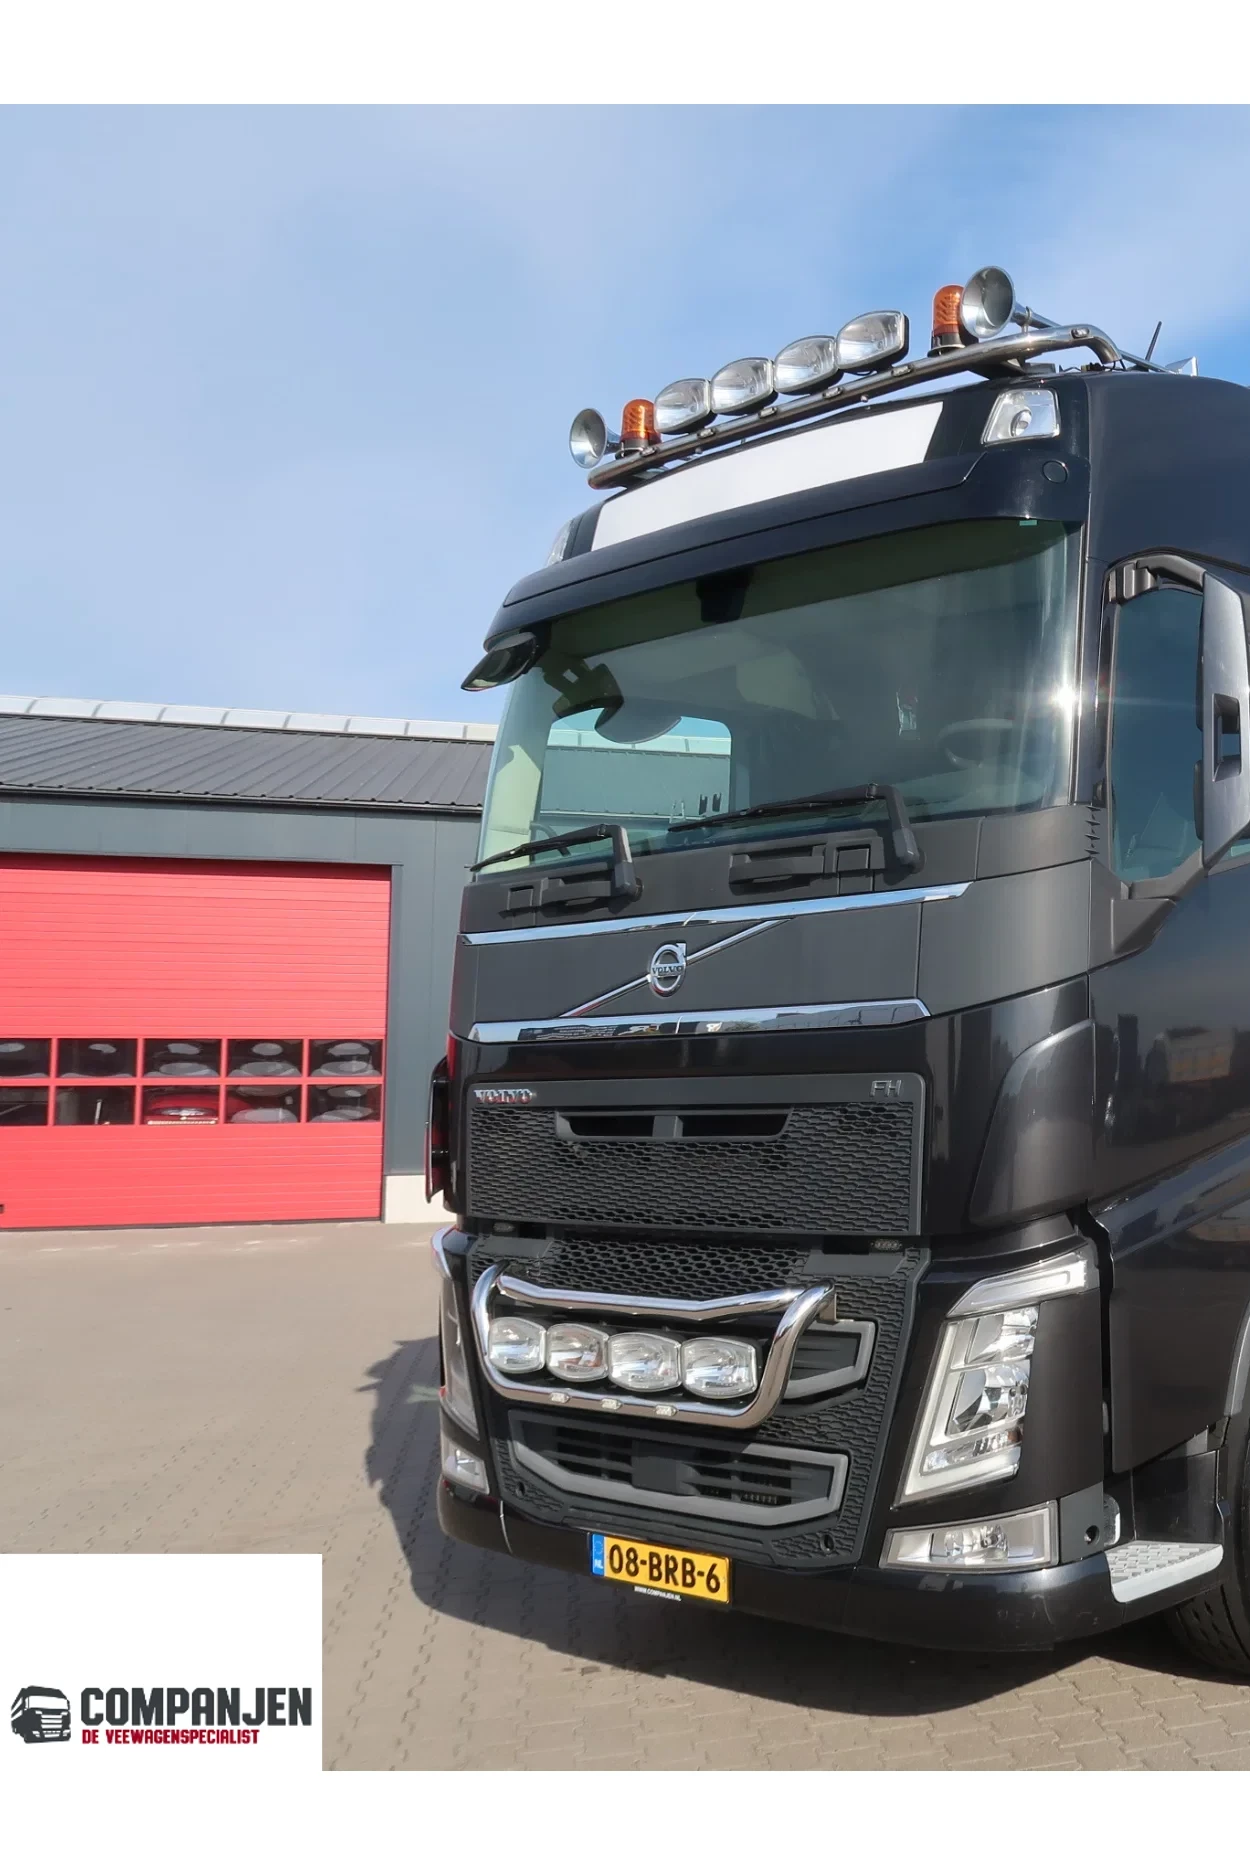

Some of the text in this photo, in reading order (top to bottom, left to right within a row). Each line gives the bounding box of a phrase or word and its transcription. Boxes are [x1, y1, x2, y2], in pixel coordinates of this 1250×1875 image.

[652, 965, 683, 975] VOLVO
[474, 1088, 533, 1104] VOLVO
[870, 1079, 903, 1097] FH
[608, 1543, 721, 1594] 08-BRB-6
